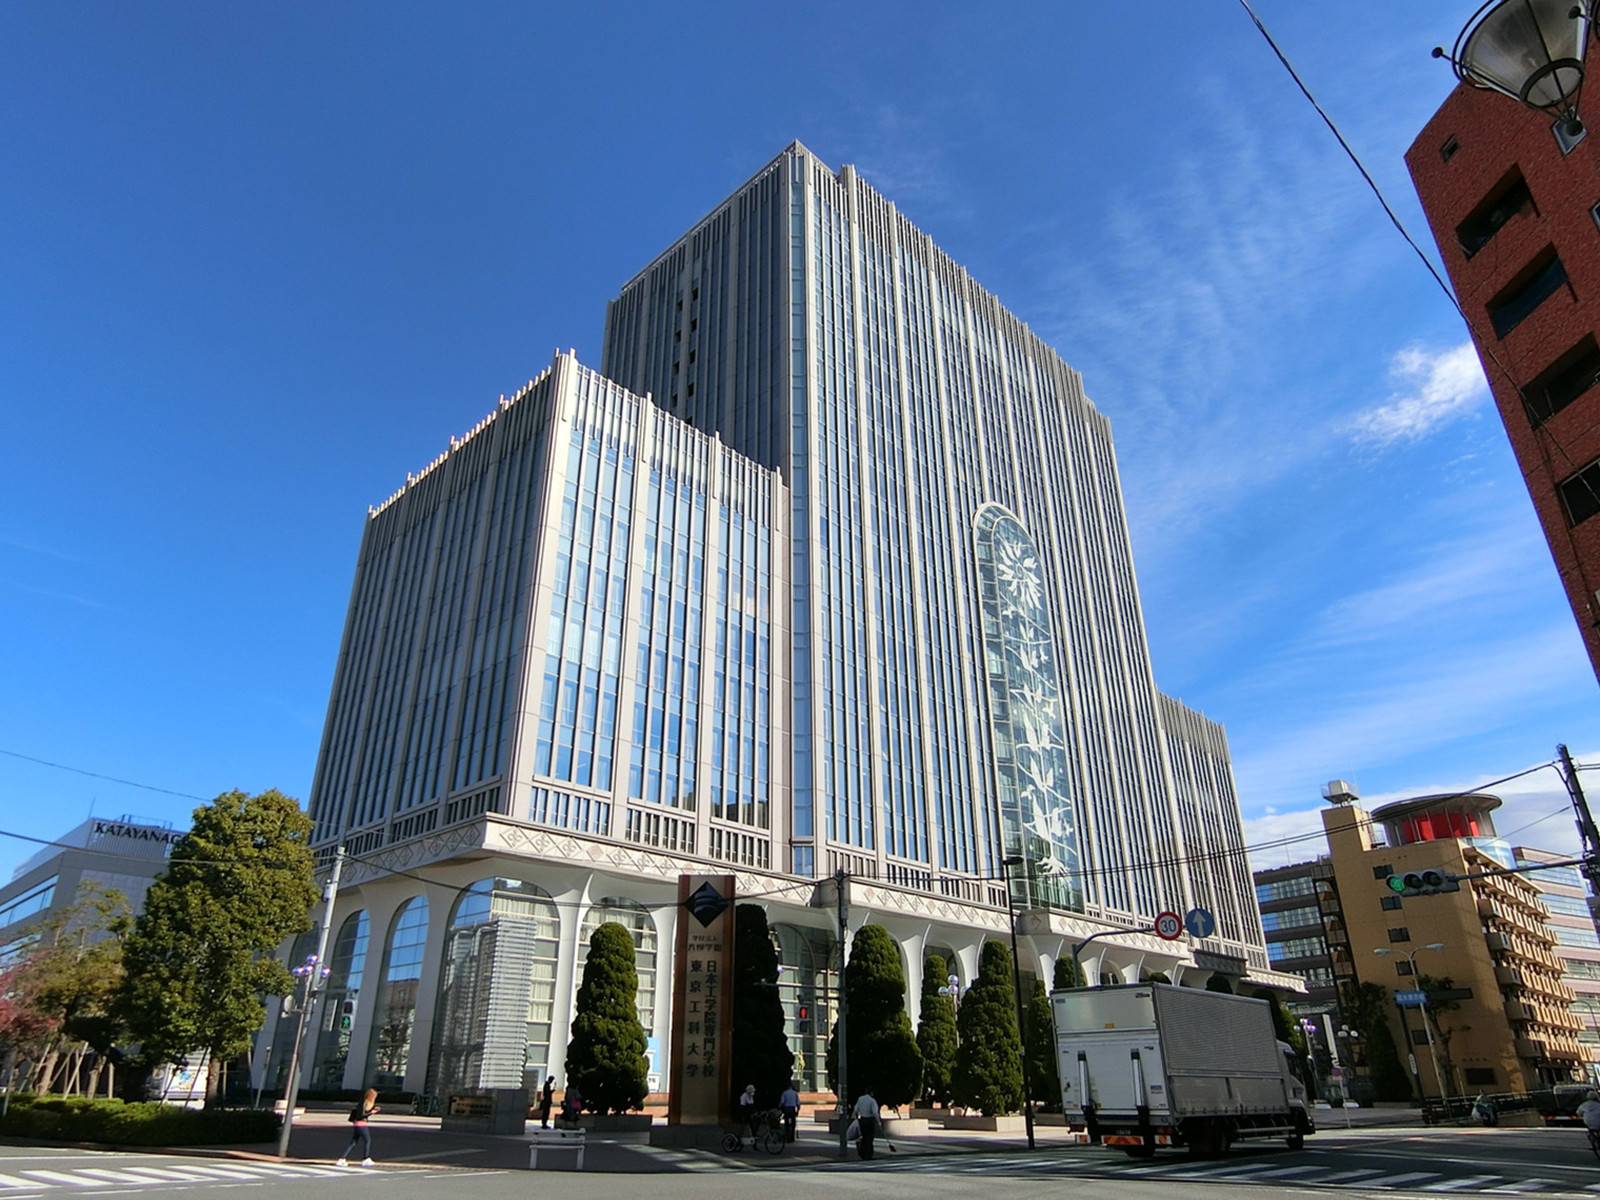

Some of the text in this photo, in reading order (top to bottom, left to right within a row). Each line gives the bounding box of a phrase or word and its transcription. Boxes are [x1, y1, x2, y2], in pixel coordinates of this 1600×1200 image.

[95, 822, 187, 844] KATAYANAG
[1160, 919, 1177, 933] 30
[686, 960, 703, 1077] 東京工科大学
[703, 960, 718, 1077] 日本工学院専門学校
